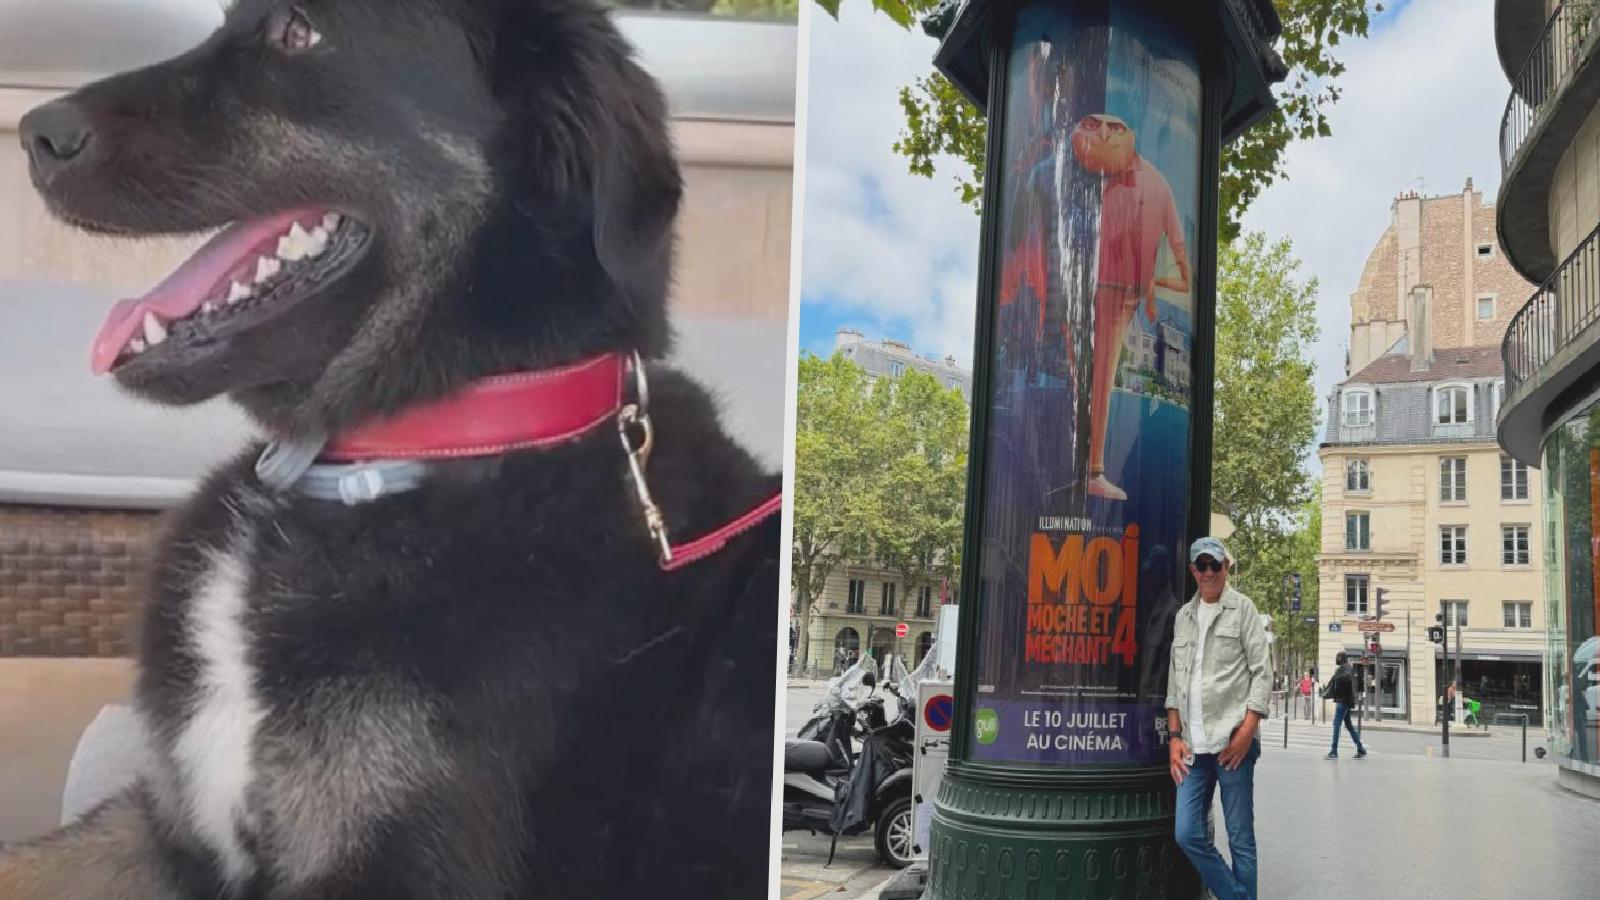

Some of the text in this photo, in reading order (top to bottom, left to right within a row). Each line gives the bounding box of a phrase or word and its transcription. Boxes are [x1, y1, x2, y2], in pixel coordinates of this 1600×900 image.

[1039, 516, 1092, 531] ILLUMINATION
[1027, 603, 1113, 634] MOCHE ET
[1111, 606, 1137, 665] 4
[1024, 710, 1127, 728] LE 10 JUILLET
[1155, 717, 1169, 730] BF
[1026, 731, 1122, 750] AU CINÉMA
